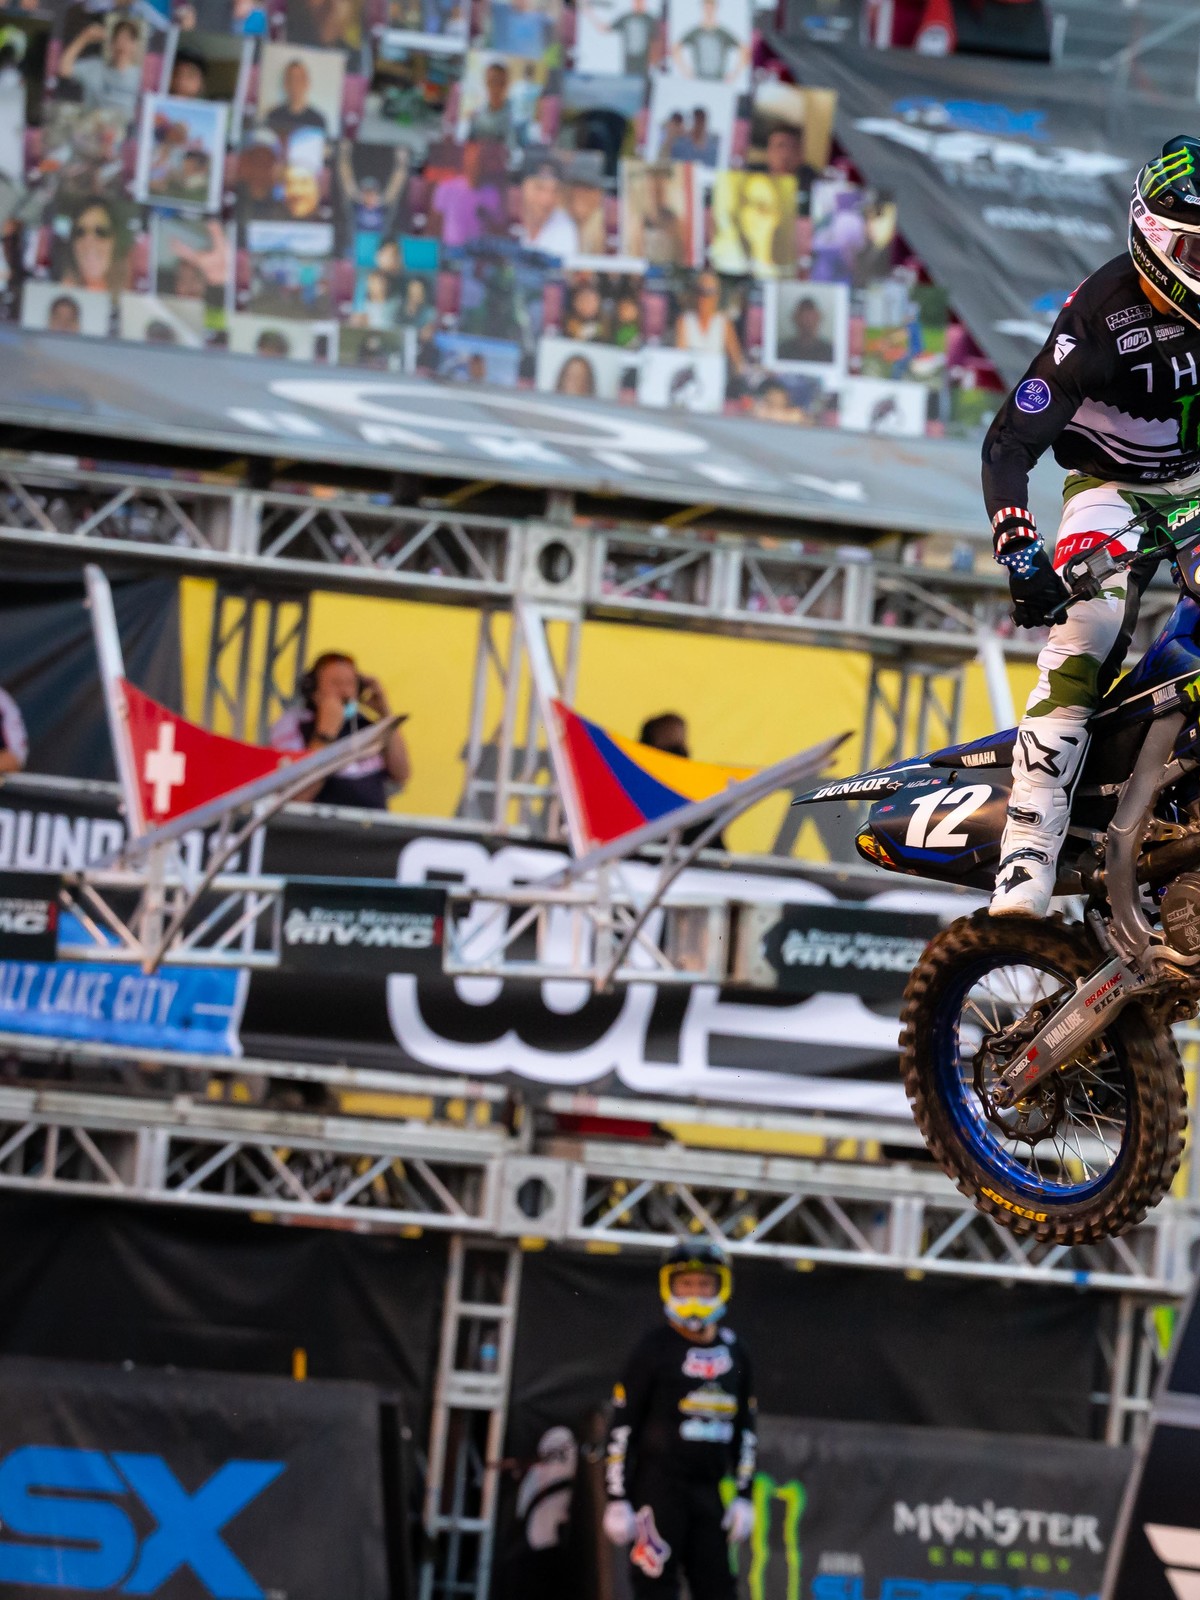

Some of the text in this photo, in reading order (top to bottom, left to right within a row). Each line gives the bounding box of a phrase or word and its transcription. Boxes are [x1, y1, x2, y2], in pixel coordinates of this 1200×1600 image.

[1122, 331, 1148, 350] 100%
[960, 750, 997, 768] YAMAHA
[812, 777, 891, 800] DUNLOP
[904, 783, 993, 849] 12
[39, 966, 113, 1021] LAKE
[111, 974, 180, 1026] CITY
[1084, 972, 1122, 1008] BRAKING
[1042, 1008, 1085, 1050] YAMALUBE
[0, 1444, 287, 1600] SX
[893, 1497, 1104, 1553] MONSTER
